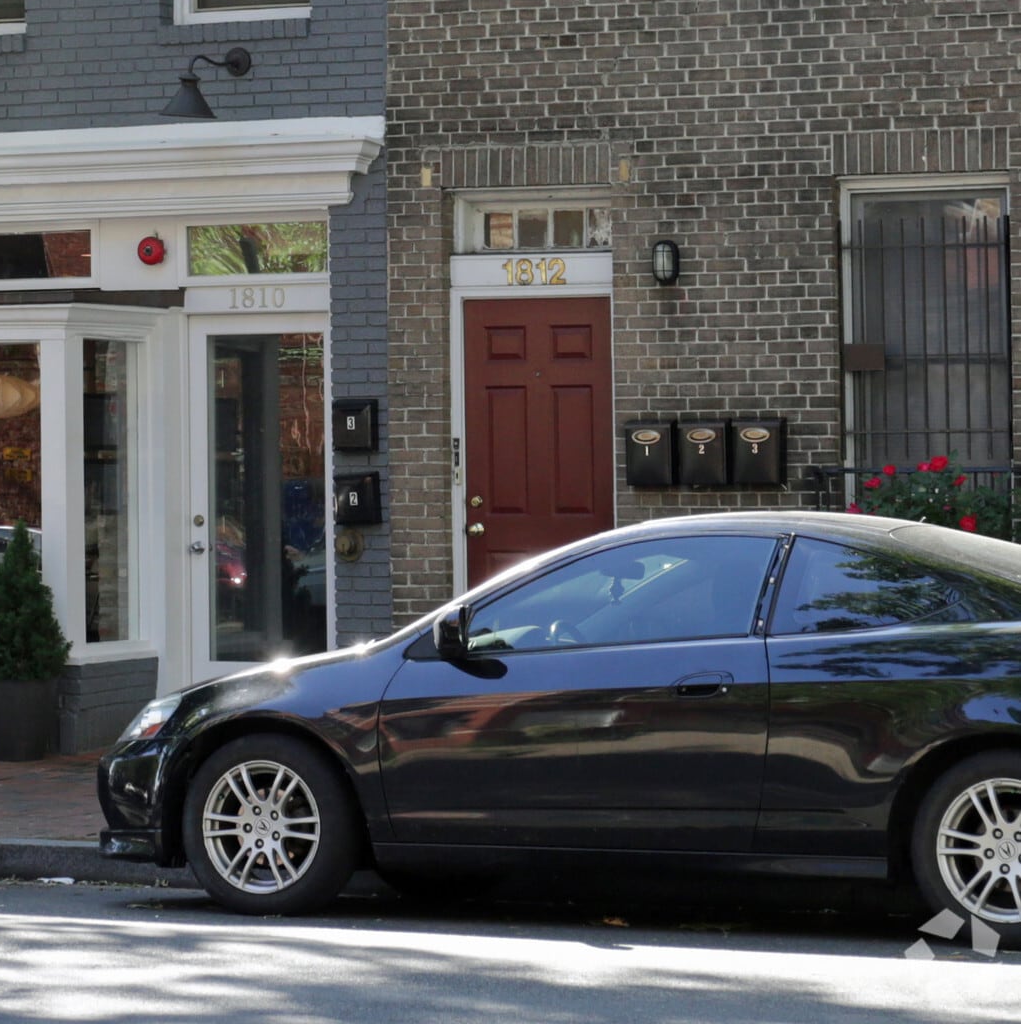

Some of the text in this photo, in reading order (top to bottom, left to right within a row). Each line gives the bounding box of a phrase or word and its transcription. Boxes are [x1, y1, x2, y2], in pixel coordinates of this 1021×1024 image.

[501, 257, 567, 286] 1812
[228, 287, 286, 309] 1810
[347, 417, 354, 429] 3
[644, 445, 649, 456] 1
[698, 444, 705, 455] 2
[751, 443, 759, 454] 3
[350, 493, 357, 505] 2
